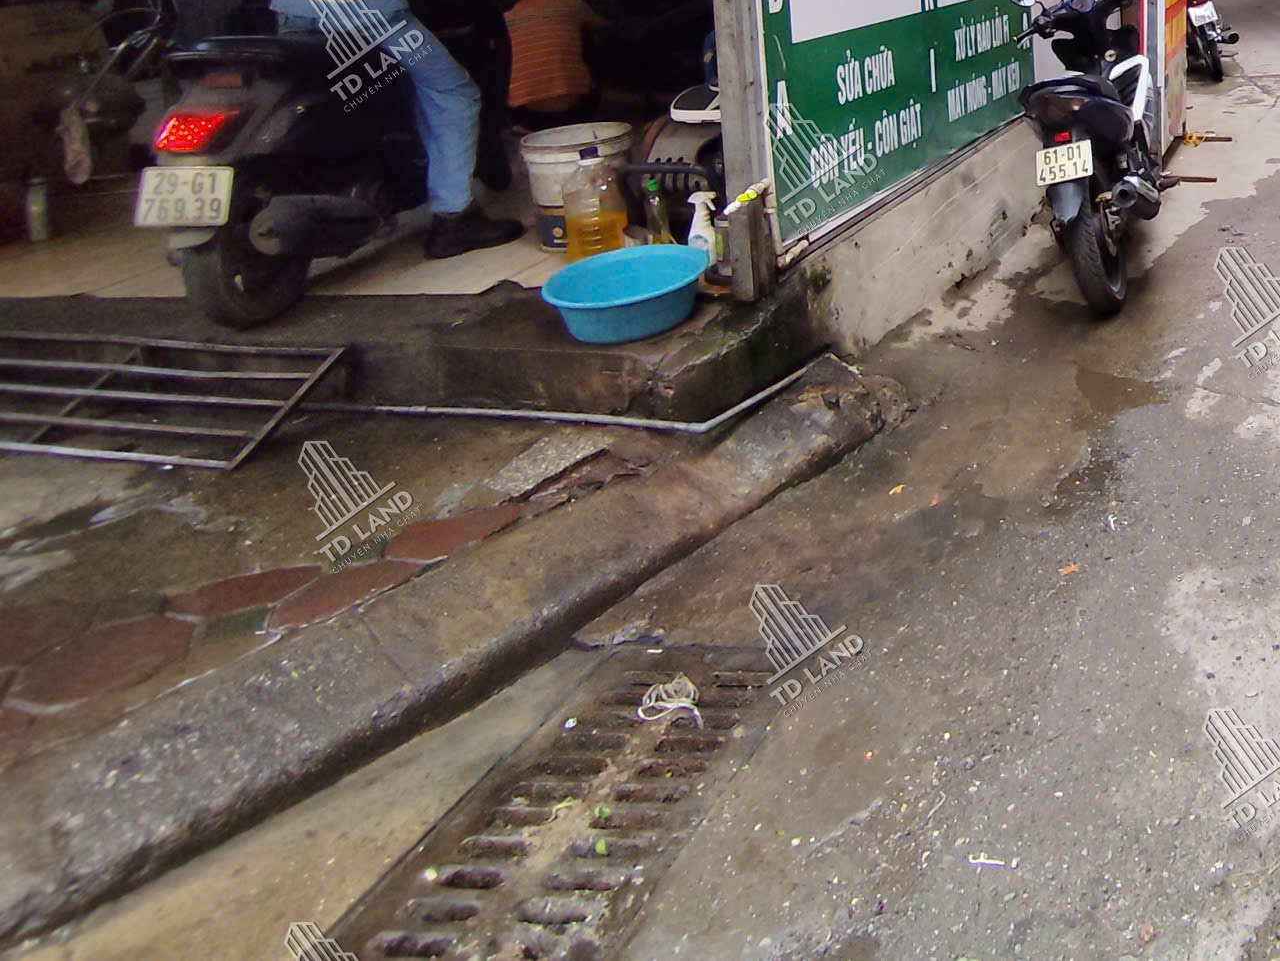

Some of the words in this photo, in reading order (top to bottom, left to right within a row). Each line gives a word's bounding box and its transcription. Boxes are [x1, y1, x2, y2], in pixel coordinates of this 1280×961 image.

[836, 48, 863, 106] SỬA
[864, 45, 896, 95] CHỮA
[874, 109, 899, 158] CÔN
[1043, 143, 1082, 166] 61-D1
[1039, 159, 1089, 183] 455.14
[153, 172, 217, 196] 29-G1
